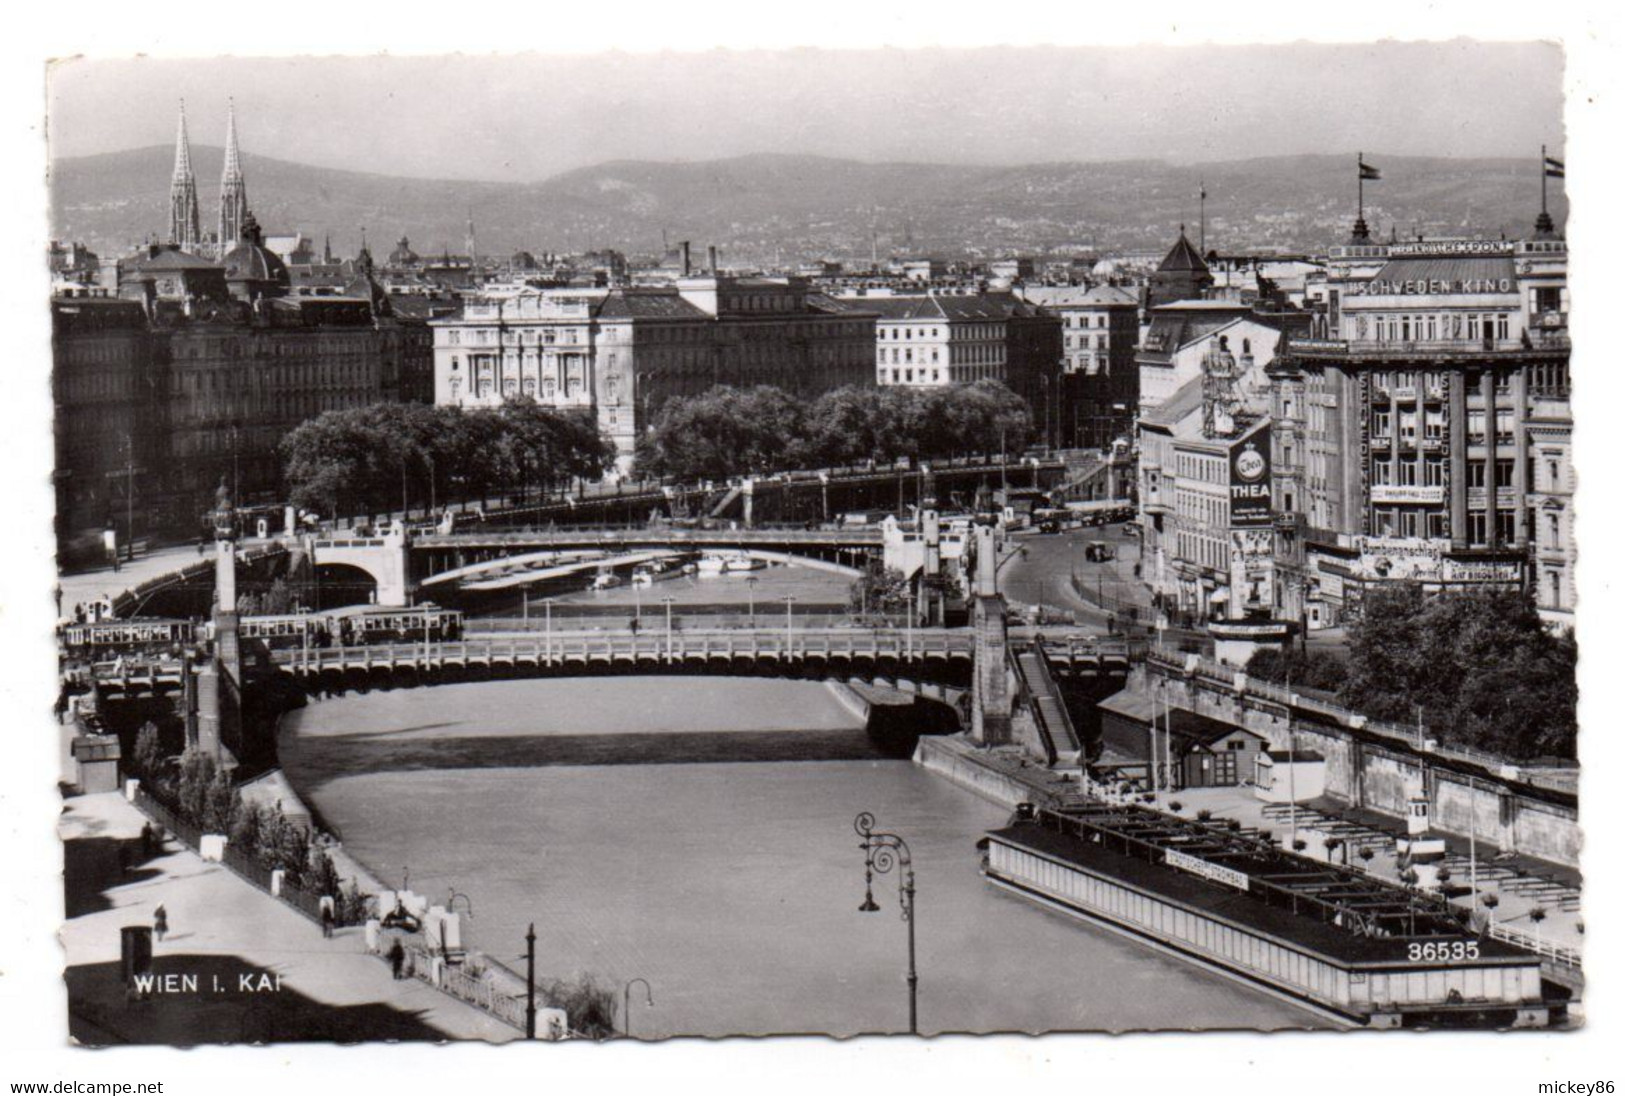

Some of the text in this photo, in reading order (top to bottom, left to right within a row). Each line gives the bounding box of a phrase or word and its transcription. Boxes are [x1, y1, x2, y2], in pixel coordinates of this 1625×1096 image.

[1358, 278, 1510, 296] SCHWEDEN KINO
[1230, 484, 1271, 498] THEA
